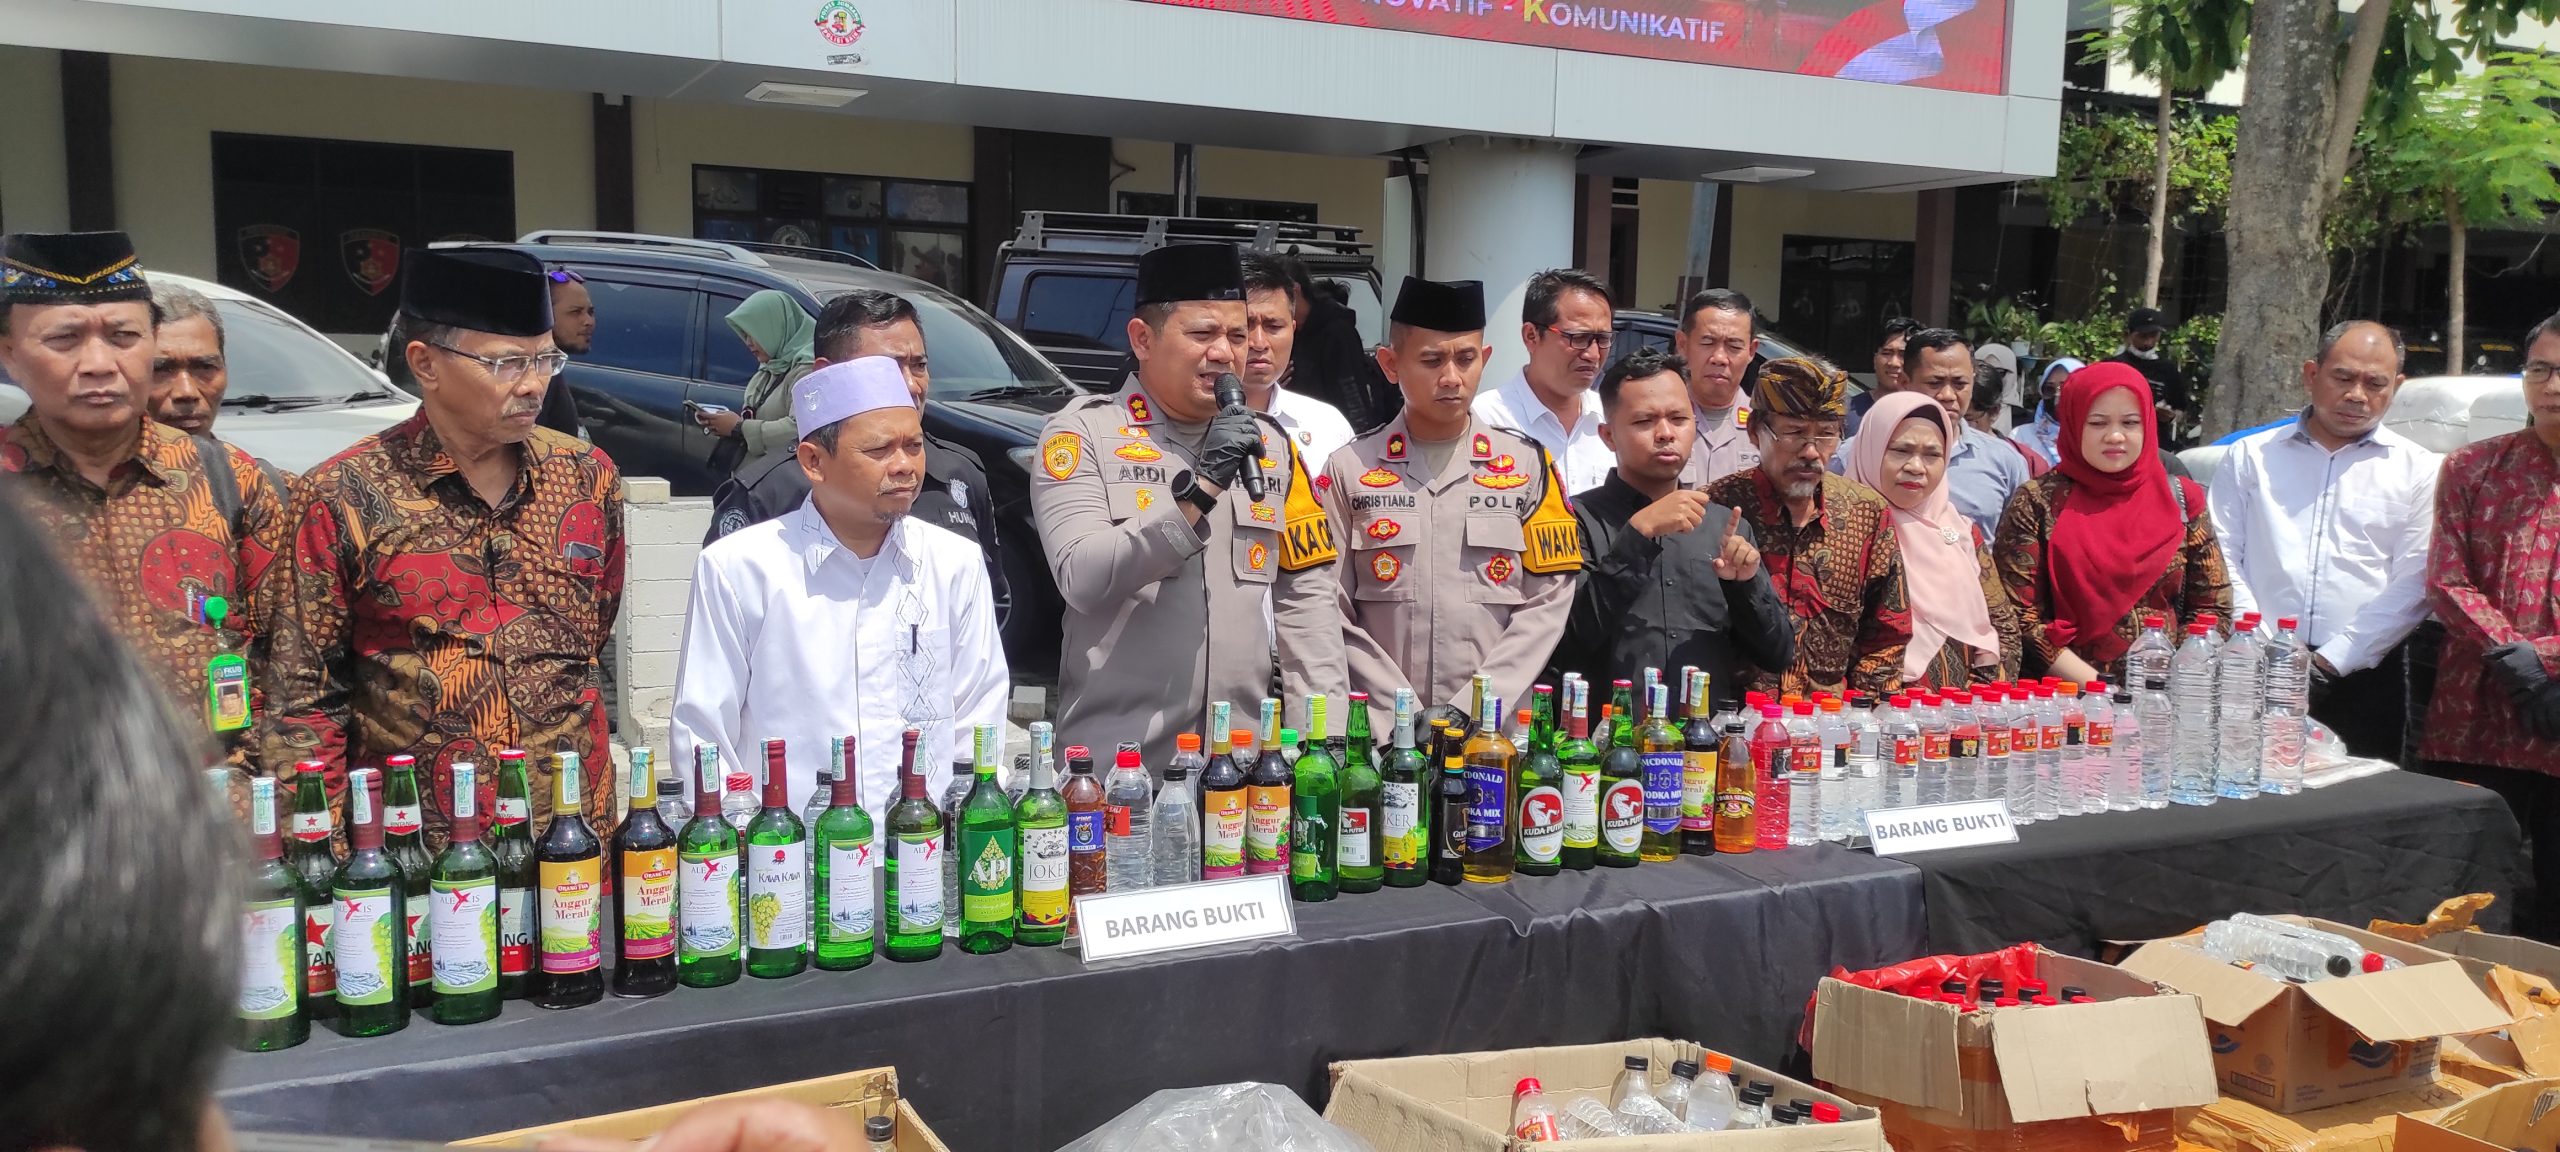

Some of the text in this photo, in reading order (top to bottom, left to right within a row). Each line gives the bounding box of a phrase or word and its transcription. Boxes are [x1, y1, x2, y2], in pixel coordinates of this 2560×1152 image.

[1523, 0, 1726, 44] KOMUNIKATIF
[1119, 464, 1166, 483] ARDI
[1235, 470, 1281, 494] PRI
[1351, 494, 1416, 511] CHRISTIAN.B
[1469, 495, 1526, 512] POLR
[1463, 770, 1504, 784] CDONALD
[1383, 812, 1411, 828] KER
[1484, 808, 1502, 818] MIX
[1250, 814, 1281, 827] Anggur
[1606, 818, 1629, 828] KUDA
[1875, 813, 2006, 840] BARANG BUKTI
[1252, 823, 1278, 833] Merah
[1523, 826, 1545, 836] KUDA
[637, 884, 673, 896] Anggur
[552, 897, 593, 911] Anggur
[640, 894, 671, 907] Merah
[555, 907, 590, 920] Merah
[1105, 901, 1265, 939] BARANG BUKTI
